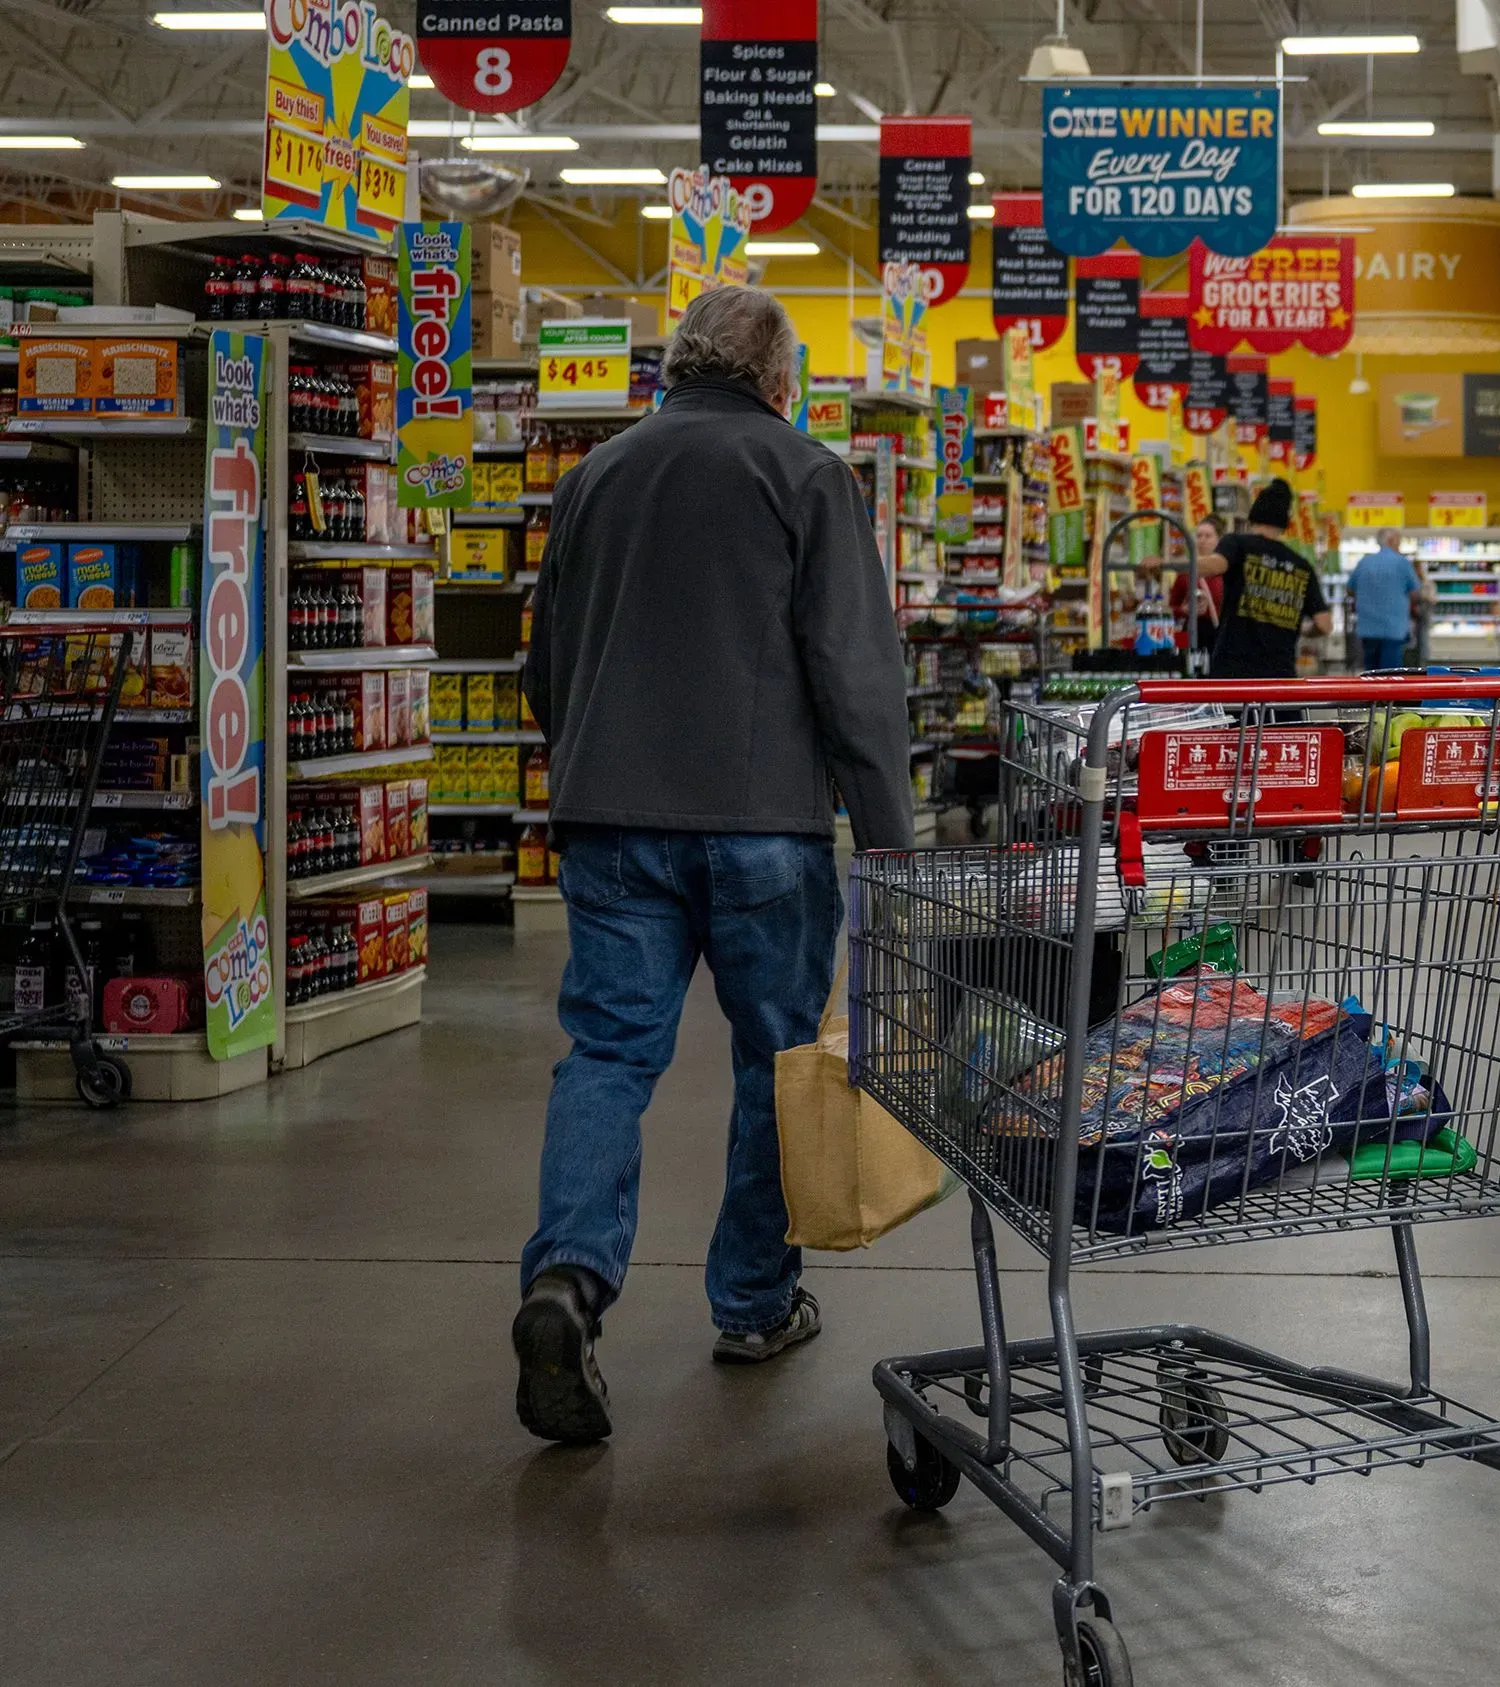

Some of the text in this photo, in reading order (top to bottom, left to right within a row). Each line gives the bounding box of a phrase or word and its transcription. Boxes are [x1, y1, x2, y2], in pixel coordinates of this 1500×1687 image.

[270, 0, 361, 61] Combo
[422, 14, 563, 31] Canned Pasta
[732, 44, 785, 61] Spices
[473, 47, 513, 95] 8
[704, 67, 813, 84] Flour & Sugar
[275, 90, 319, 121] Buy this!
[704, 90, 813, 107] Baking Needs
[743, 109, 773, 121] Oil &
[1050, 108, 1274, 137] ONE WINNER
[726, 119, 790, 132] Shortening
[366, 123, 405, 153] You save!
[730, 135, 787, 150] Gelatin
[324, 142, 357, 174] free!
[714, 158, 803, 173] Cake Mixes
[904, 160, 945, 172] Cereal
[1087, 139, 1241, 184] Every Day
[744, 183, 774, 220] 9
[1070, 186, 1252, 215] FOR 120 DAYS
[891, 215, 958, 225] Hot Cereal
[415, 233, 450, 246] Look
[897, 231, 951, 244] Pudding
[411, 249, 458, 262] what's
[883, 249, 965, 261] Canned Fruit
[1017, 244, 1044, 254] Nuts
[997, 259, 1064, 269] Meat Snacks
[1204, 250, 1341, 279] Win FREE
[1001, 274, 1060, 285] Rice Cakes
[993, 289, 1042, 300] Breakfast
[1203, 281, 1341, 308] GROCERIES
[1217, 309, 1326, 328] FOR A YEAR!
[413, 268, 460, 416] free!
[590, 335, 622, 343] COUPON
[101, 342, 169, 357] MANISCHEWITZ
[217, 357, 252, 387] Look
[1092, 357, 1122, 380] 12
[213, 398, 260, 427] what's
[943, 412, 968, 495] free!
[405, 457, 465, 485] Combo
[25, 564, 49, 575] mac
[25, 571, 57, 582] cheese
[77, 564, 101, 575] mac
[78, 571, 111, 582] cheese
[208, 441, 260, 829] free!
[1309, 746, 1319, 784] AVISO
[1424, 744, 1436, 784] WARNING
[206, 918, 270, 1031] Combo Loco
